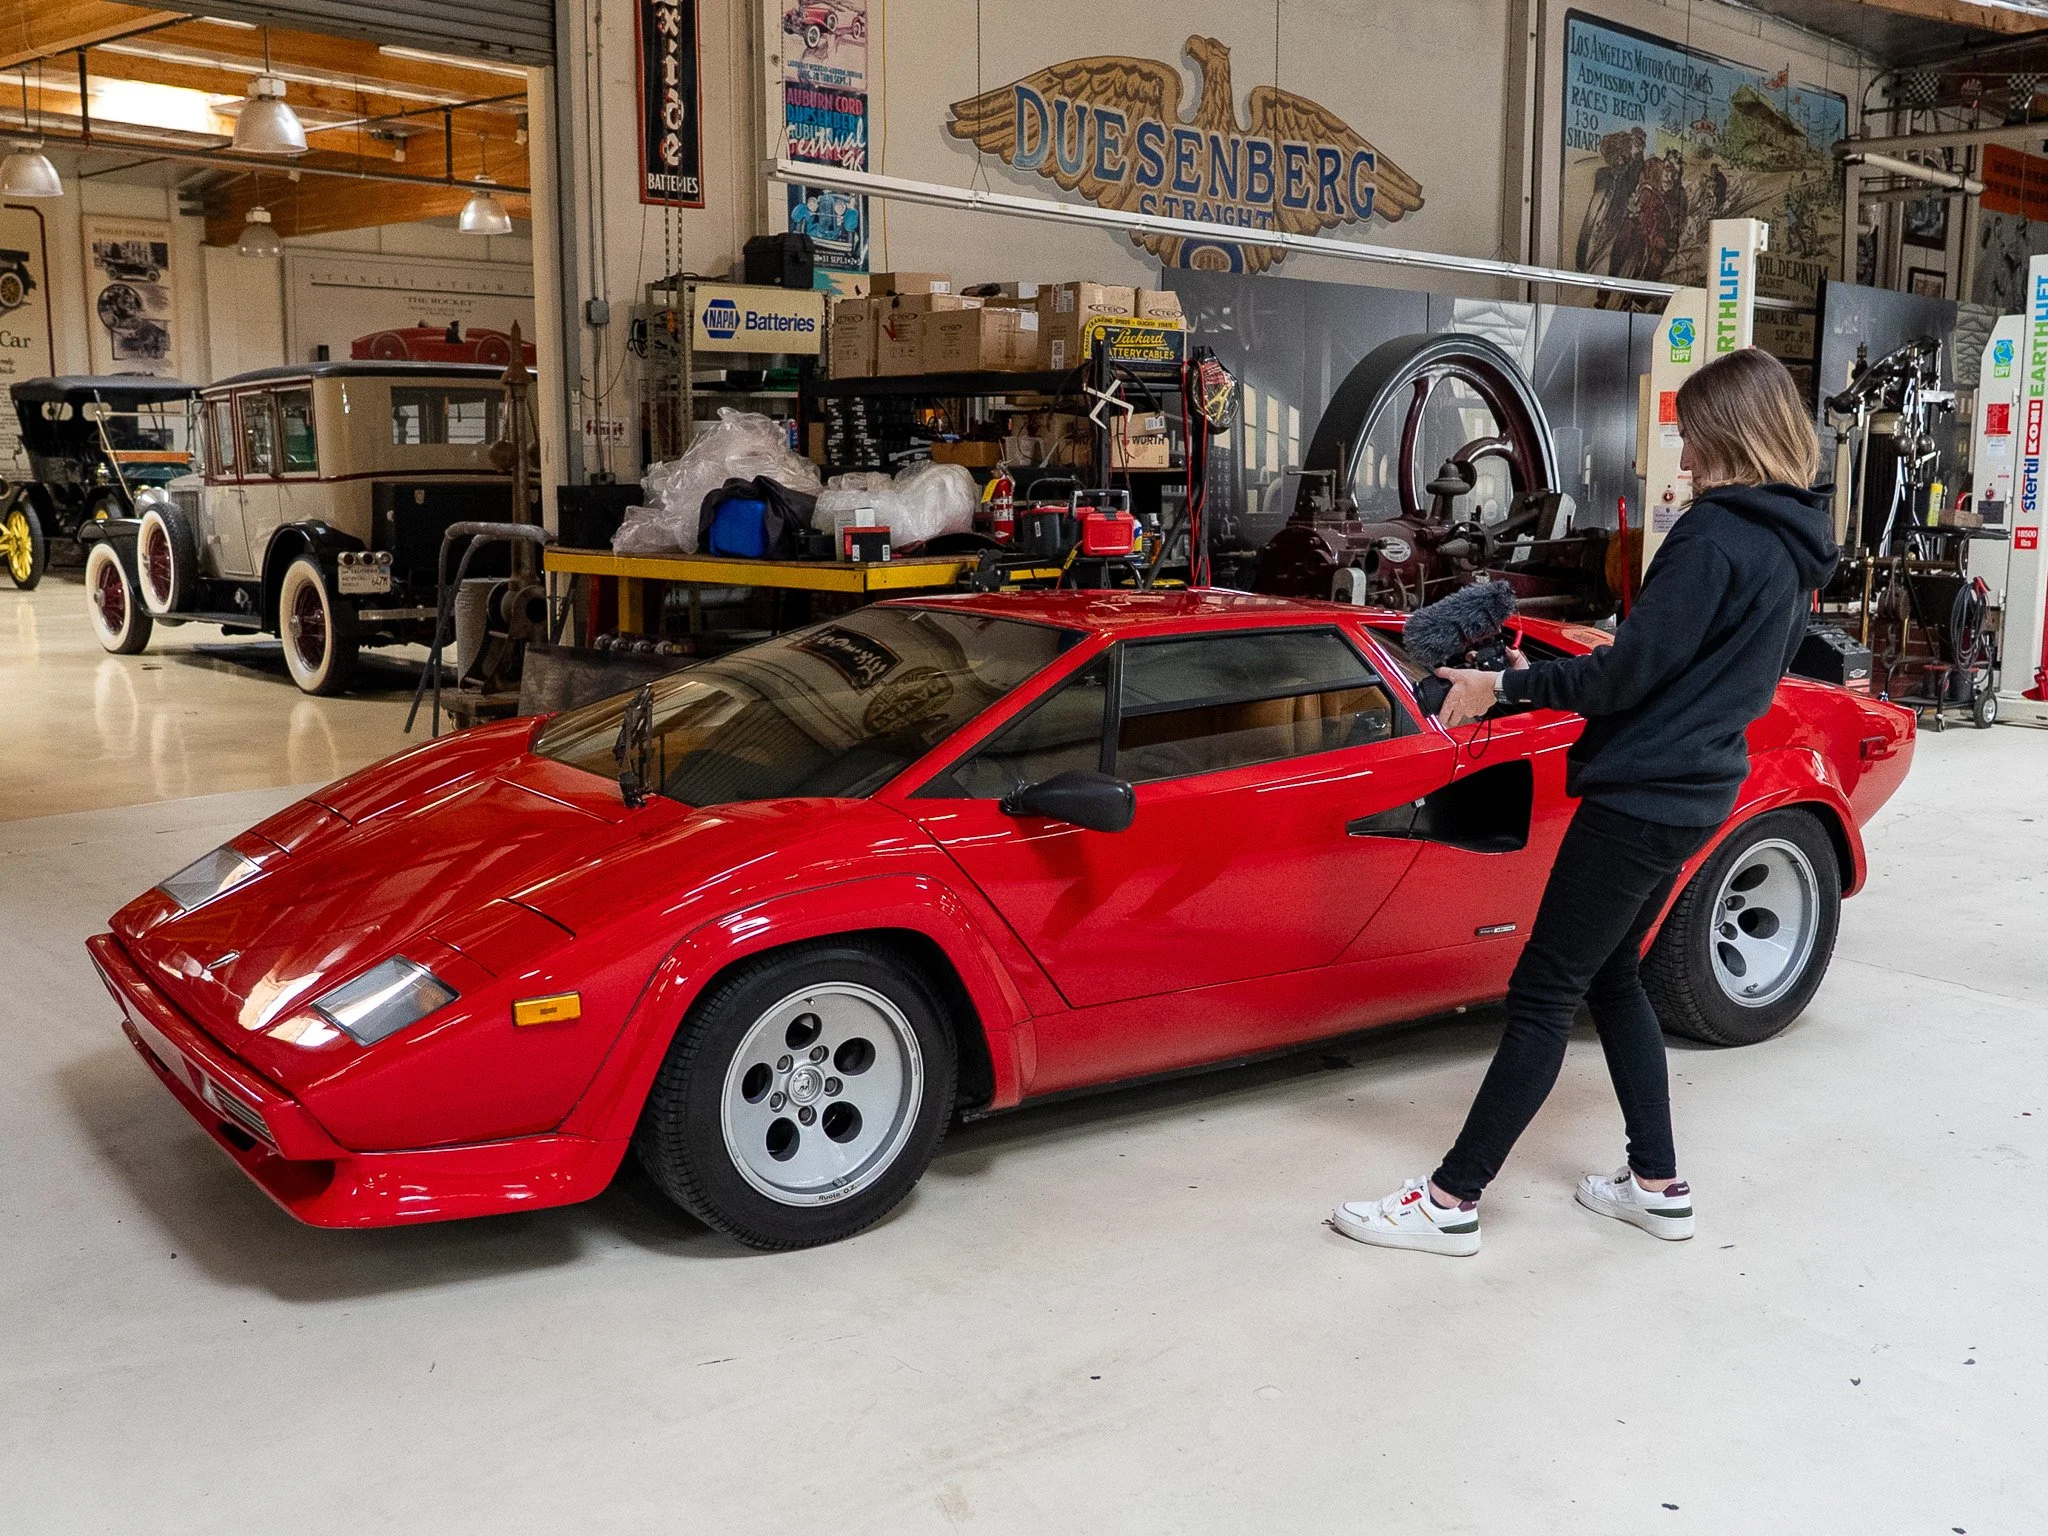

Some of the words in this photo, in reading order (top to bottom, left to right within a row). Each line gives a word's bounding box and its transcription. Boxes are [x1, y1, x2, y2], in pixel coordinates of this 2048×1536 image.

[1589, 34, 1634, 72] ANGELES
[1633, 49, 1664, 80] MOTOR
[656, 0, 685, 166] xide
[1577, 62, 1635, 97] ADMISSION
[787, 87, 833, 110] AUBURN
[835, 96, 863, 115] CORD
[1571, 86, 1608, 114] RACES
[1612, 97, 1646, 123] BEGIN
[1013, 84, 1375, 220] DUESENBERG
[1567, 127, 1600, 152] SHARP
[648, 172, 699, 194] BATTERIES
[1140, 193, 1273, 231] STRAIGHT
[1096, 305, 1119, 314] CTEK
[1716, 246, 1741, 353] RTHLIFT
[708, 308, 735, 329] NAPA
[745, 310, 815, 332] Batteries
[1154, 309, 1178, 318] CTEK
[0, 330, 31, 348] Car
[1111, 328, 1166, 344] Packard
[1143, 349, 1175, 360] CABLES
[2027, 402, 2040, 453] KONI
[2024, 458, 2039, 511] stertil
[2017, 530, 2037, 538] 18500
[2020, 539, 2032, 547] lbs
